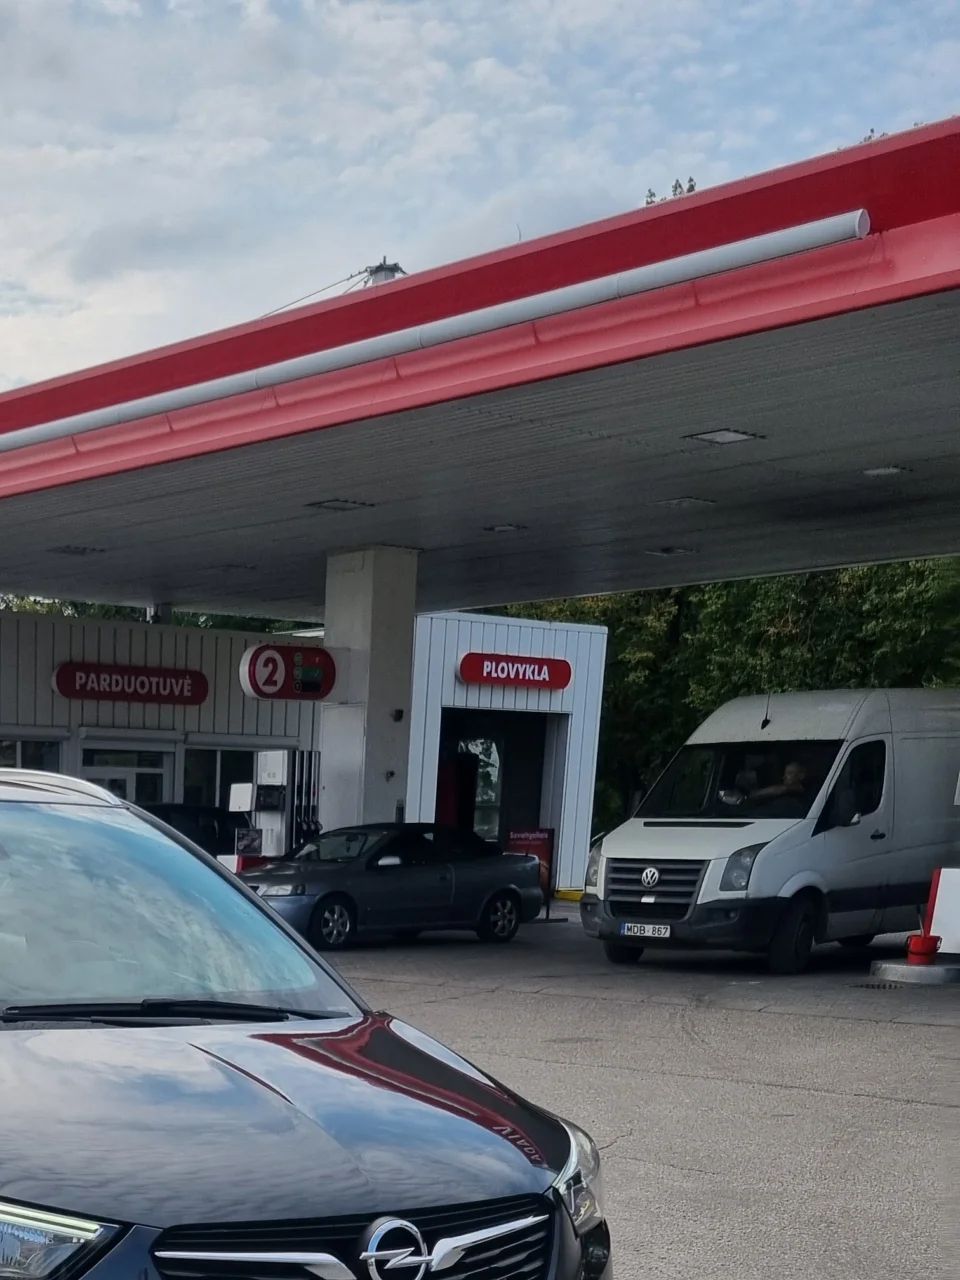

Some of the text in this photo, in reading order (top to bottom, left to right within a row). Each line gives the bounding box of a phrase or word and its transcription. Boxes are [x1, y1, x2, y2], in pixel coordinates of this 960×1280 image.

[261, 657, 278, 687] 2
[482, 660, 550, 682] PLOVYKLA
[75, 671, 192, 697] PARDUOTUVĖ
[626, 924, 669, 936] MDB 867
